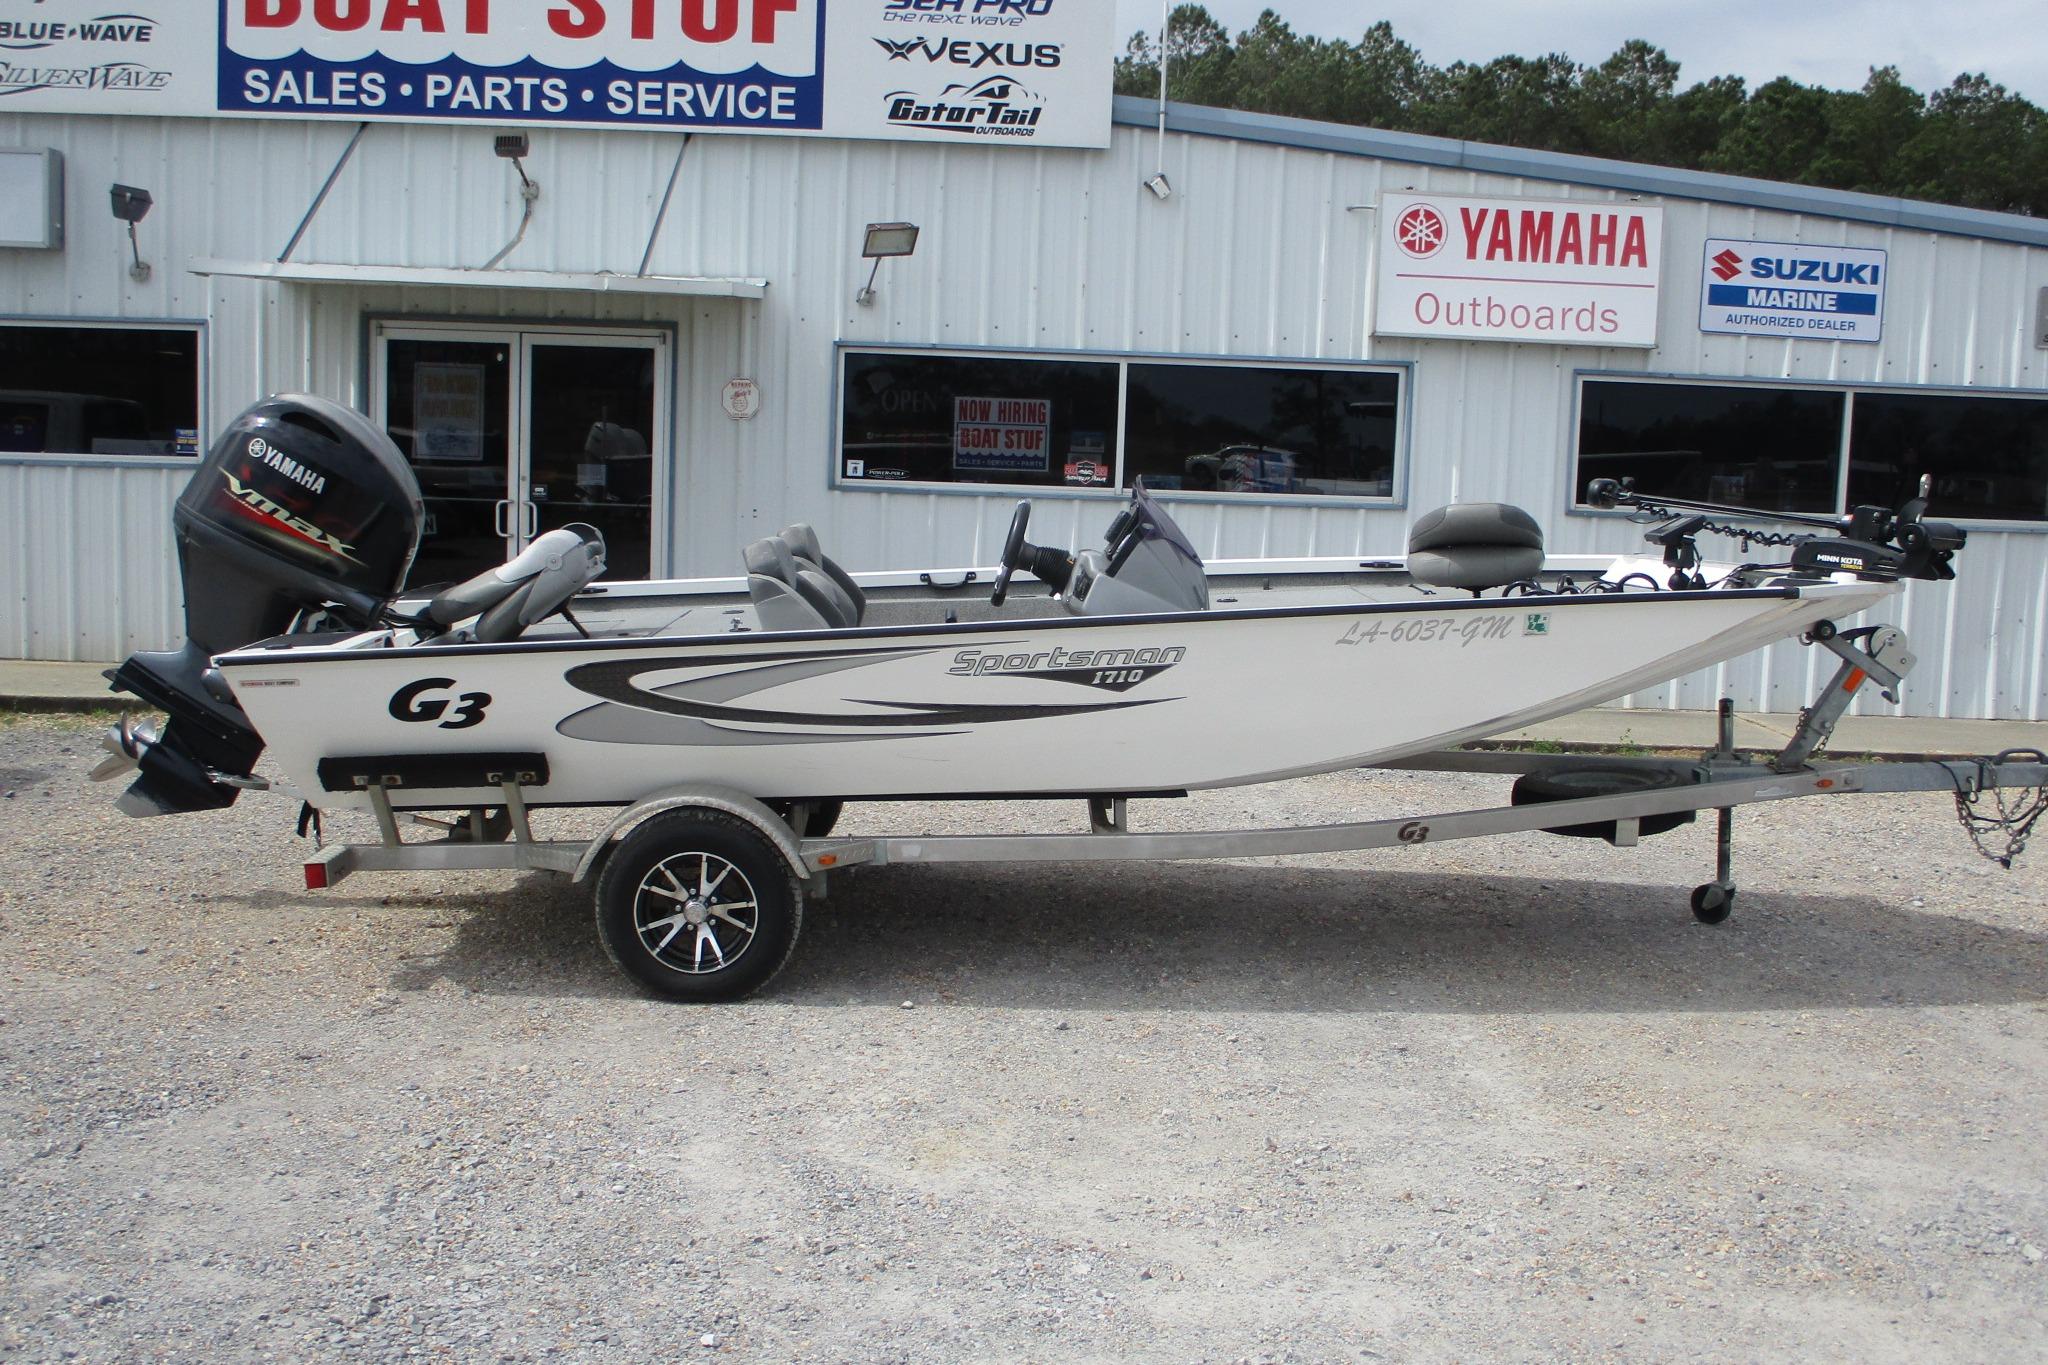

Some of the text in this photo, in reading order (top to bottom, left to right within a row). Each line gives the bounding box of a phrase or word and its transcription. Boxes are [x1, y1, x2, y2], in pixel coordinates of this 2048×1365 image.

[883, 11, 1022, 27] the next wave
[918, 37, 1061, 68] VEXUS
[243, 68, 797, 121] SALES PARTS SERVICE
[975, 126, 1035, 137] OUTBOARDS
[1460, 207, 1648, 268] YAMAHA
[1750, 257, 1879, 285] SUZUKI
[1415, 292, 1619, 333] Outboards
[1747, 288, 1837, 311] MARINE
[1725, 313, 1856, 331] AUTHORIZED DEALER
[958, 399, 1047, 424] NOW HIRING
[959, 427, 1000, 448] BOAT
[1004, 429, 1044, 450] STUF
[263, 446, 325, 495] YAMAHA
[1817, 554, 1862, 565] MINN KOTA
[1335, 615, 1515, 648] LA-6037-GM
[949, 646, 1187, 677] Sportsman
[1091, 669, 1144, 685] 1710
[388, 677, 493, 730] G3
[1397, 821, 1430, 844] G3
